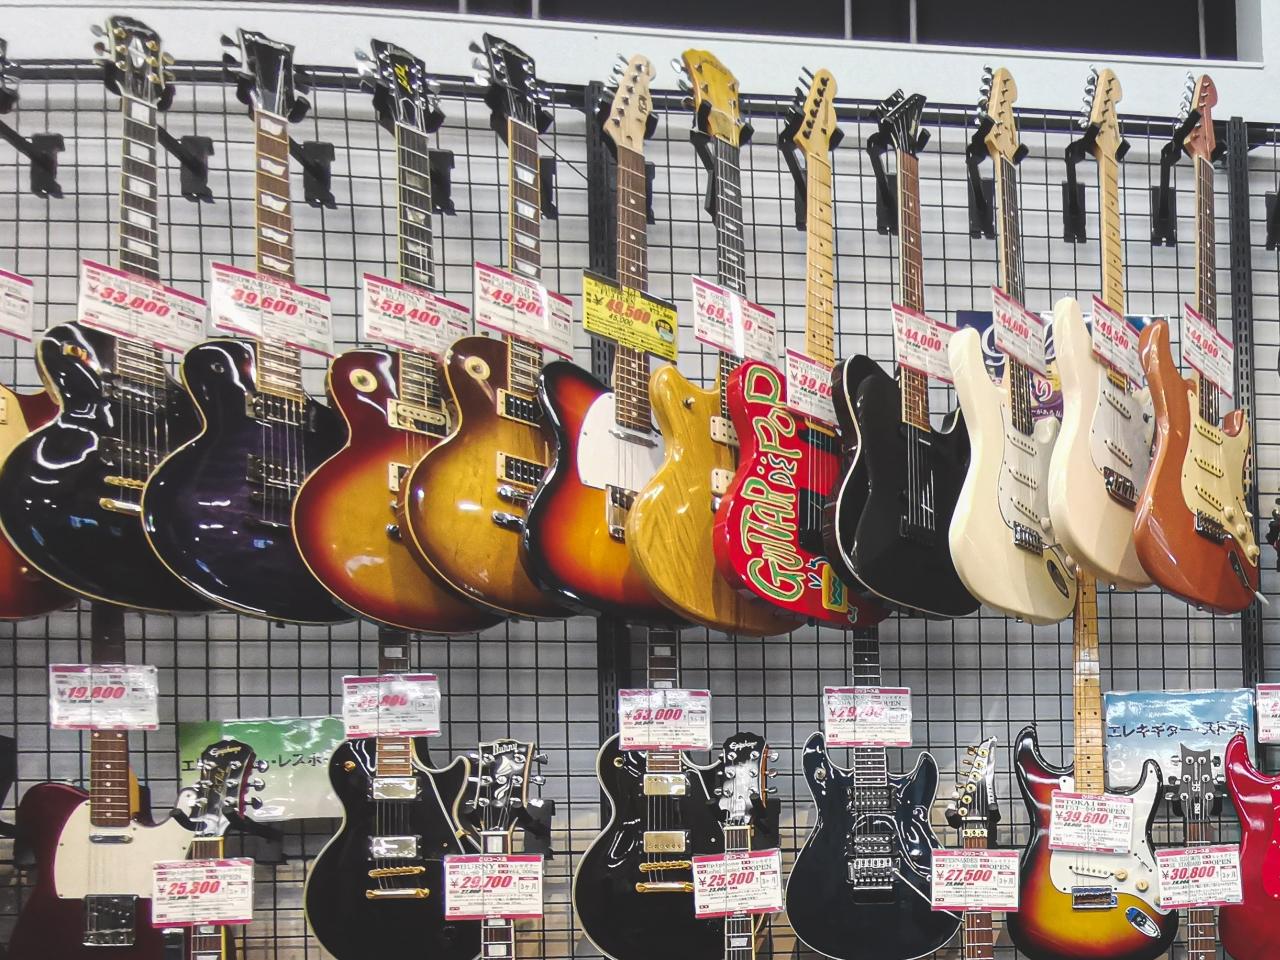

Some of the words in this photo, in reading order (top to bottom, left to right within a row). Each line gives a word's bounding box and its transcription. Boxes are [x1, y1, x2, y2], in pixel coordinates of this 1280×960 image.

[698, 871, 755, 887] ¥25,300
[936, 869, 992, 881] ¥27,500
[1161, 865, 1215, 881] ¥30,800
